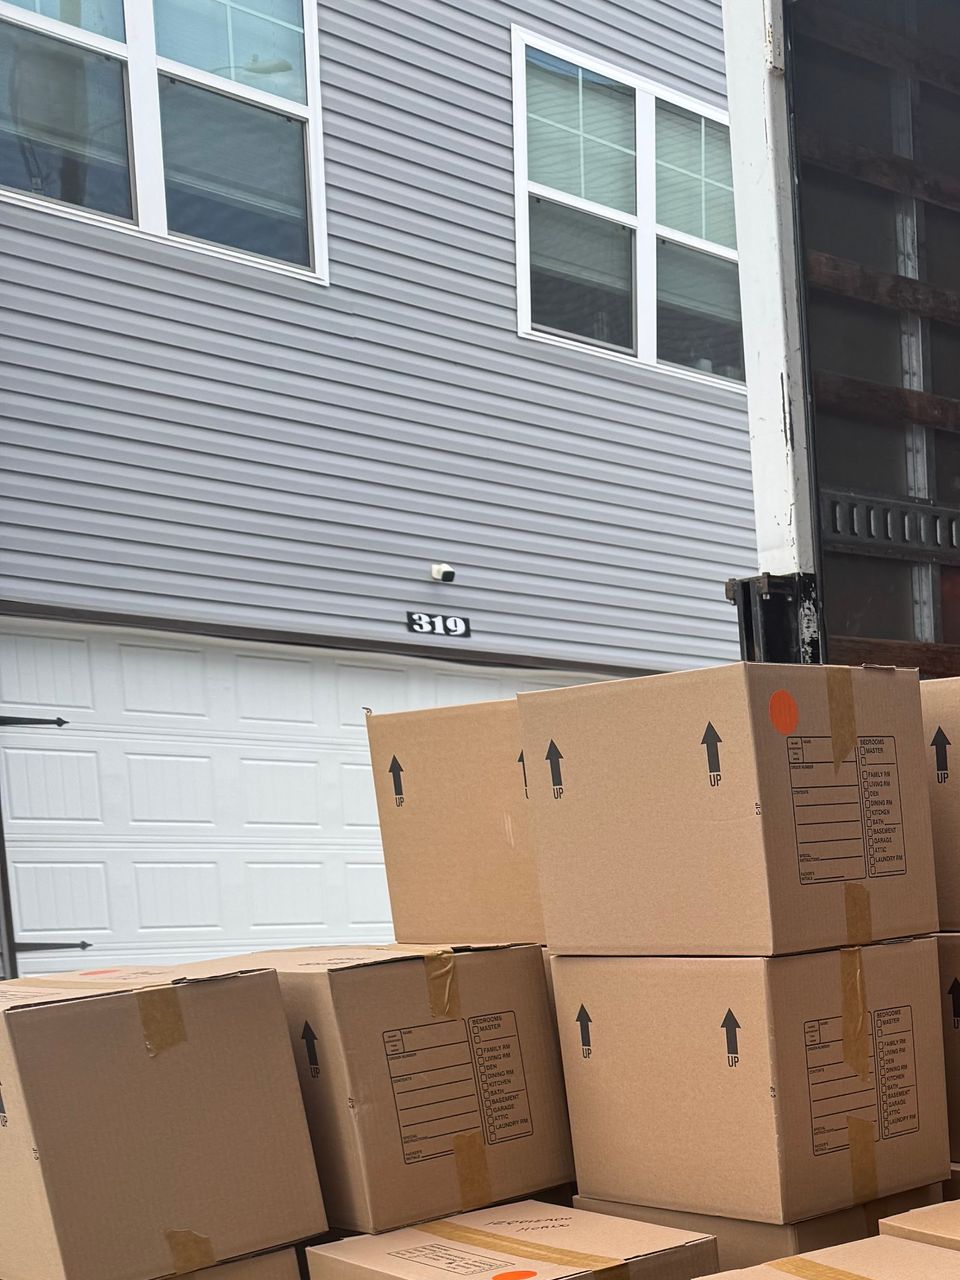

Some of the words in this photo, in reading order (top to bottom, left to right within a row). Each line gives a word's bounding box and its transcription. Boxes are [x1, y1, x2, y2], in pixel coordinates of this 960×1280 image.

[412, 614, 466, 636] 319
[709, 774, 722, 786] UP
[937, 772, 948, 784] UP
[553, 788, 564, 800] UP
[395, 796, 404, 808] UP
[472, 1016, 503, 1025] BEDROOMS
[485, 1054, 501, 1062] LIVING
[582, 1048, 592, 1058] UP
[728, 1056, 739, 1068] UP
[488, 1071, 505, 1079] DINING
[489, 1079, 511, 1087] KITCHEN
[491, 1094, 519, 1104] BASEMENT
[493, 1104, 514, 1113] GARAGE
[496, 1120, 519, 1129] LAUNDRY
